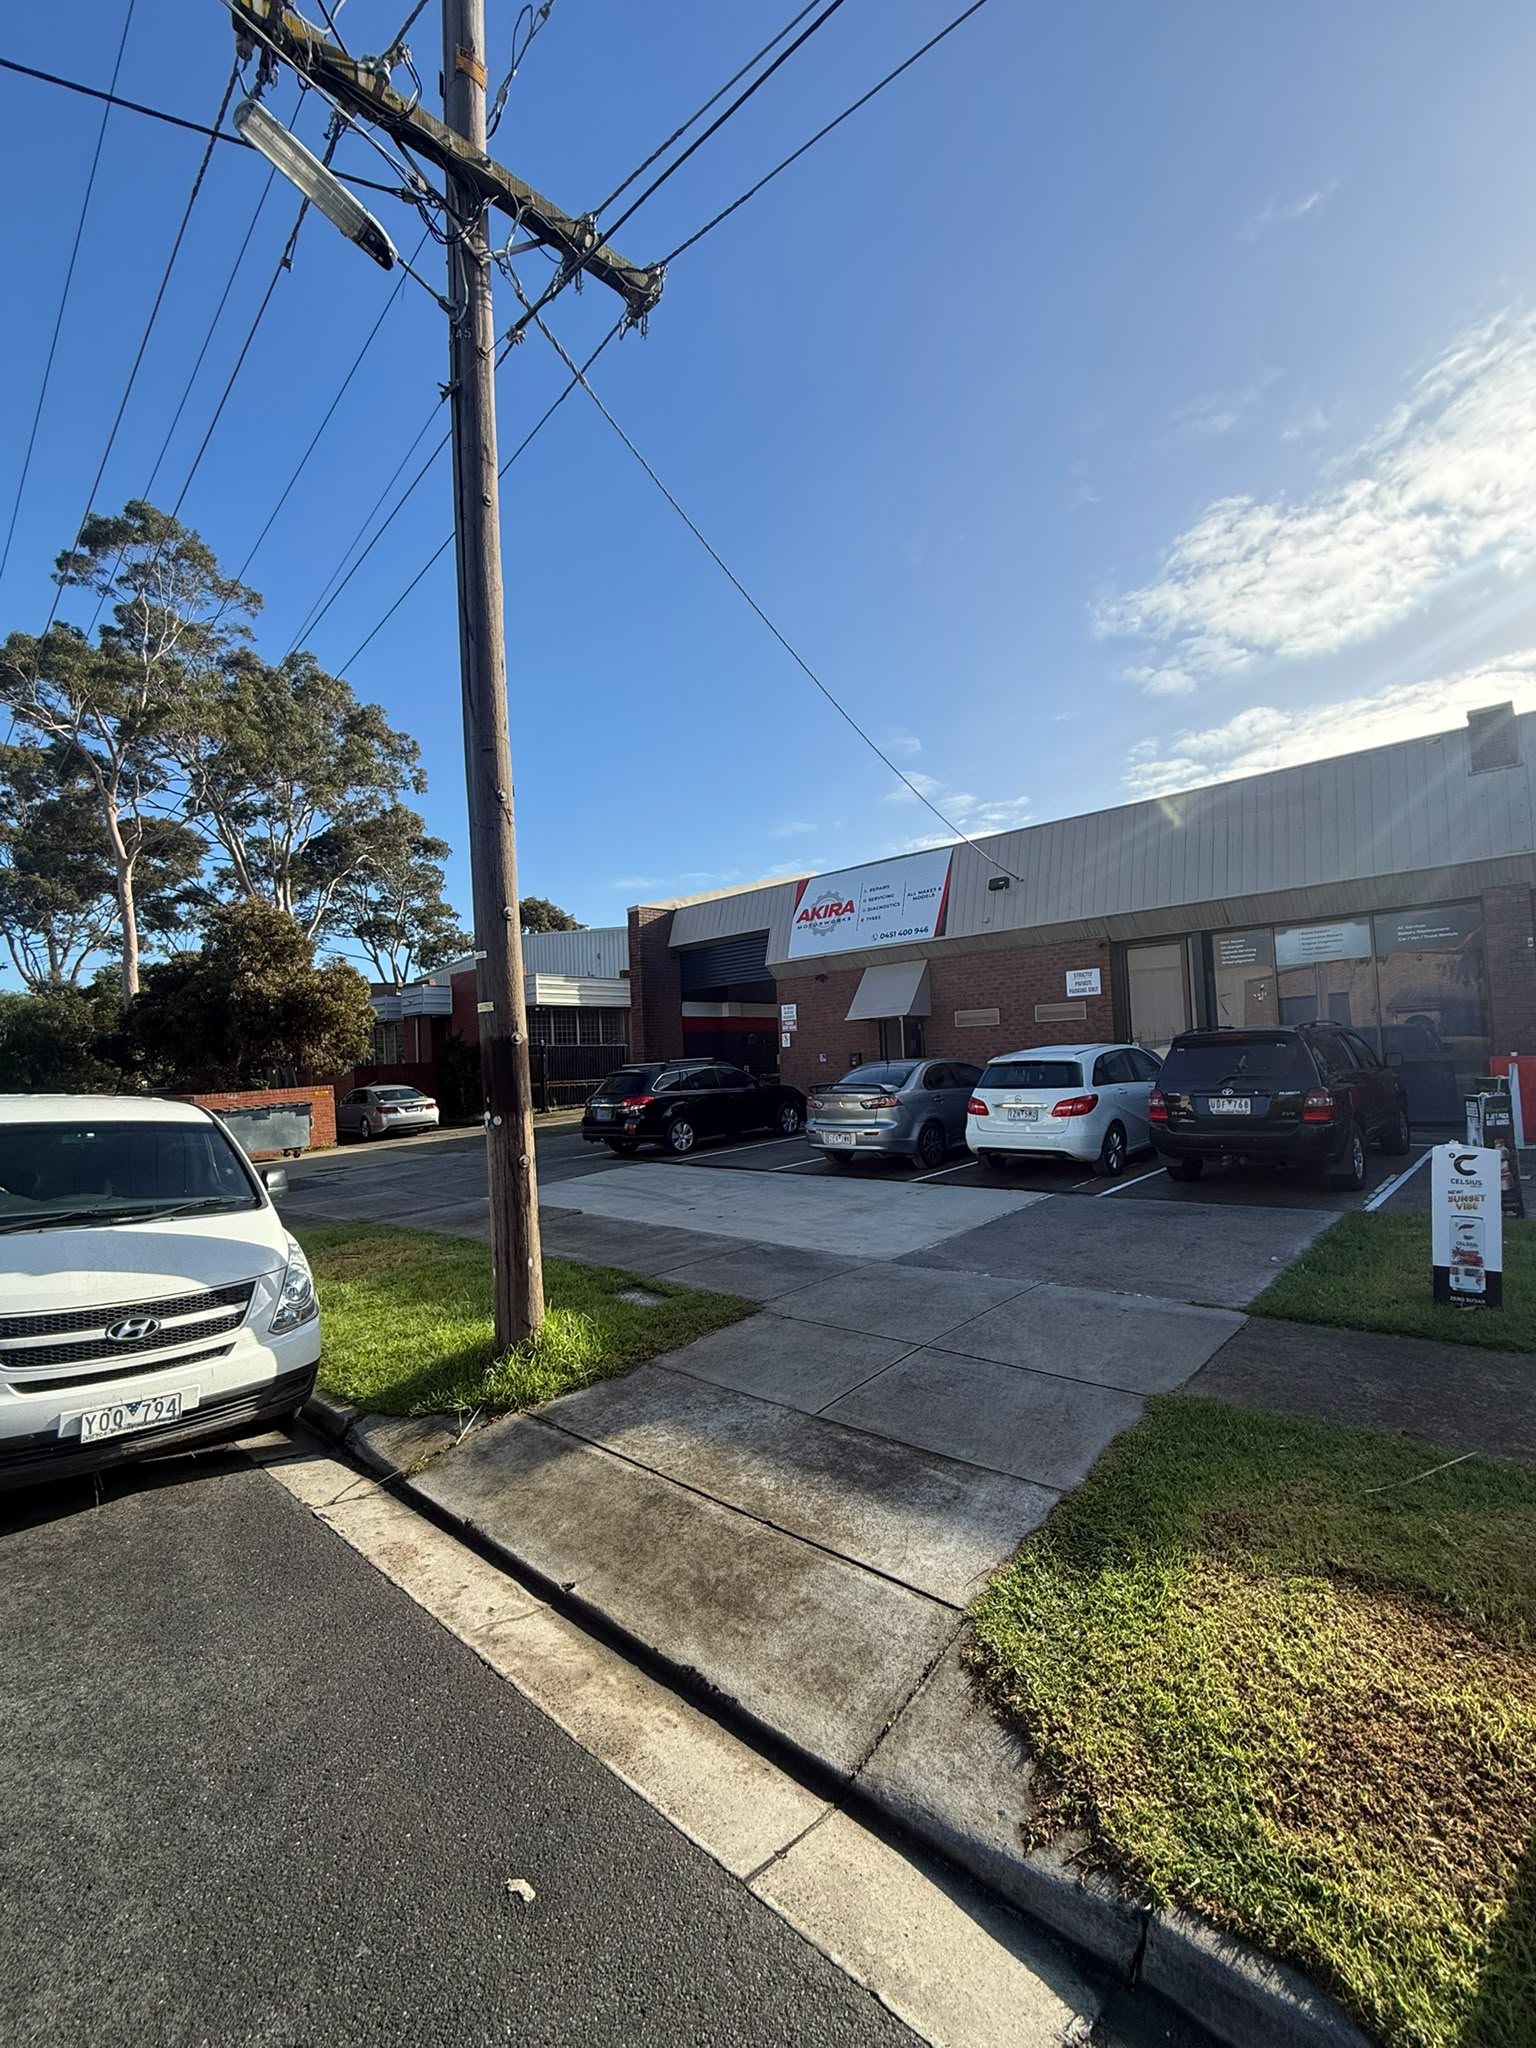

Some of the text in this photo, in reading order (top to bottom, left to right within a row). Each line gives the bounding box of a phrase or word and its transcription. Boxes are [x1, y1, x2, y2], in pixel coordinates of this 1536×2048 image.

[869, 884, 890, 892] REPAIRS
[868, 893, 895, 902] SERVICING
[796, 900, 855, 923] AKIRA
[867, 902, 901, 912] DIAGNOSTICS
[797, 917, 851, 929] MOTORWORKS
[880, 926, 929, 940] 0451 400 946
[1450, 1178, 1483, 1186] CELSIUS
[1448, 1194, 1487, 1203] SUNSET
[1456, 1202, 1479, 1211] VIBE
[142, 1398, 177, 1422] 794
